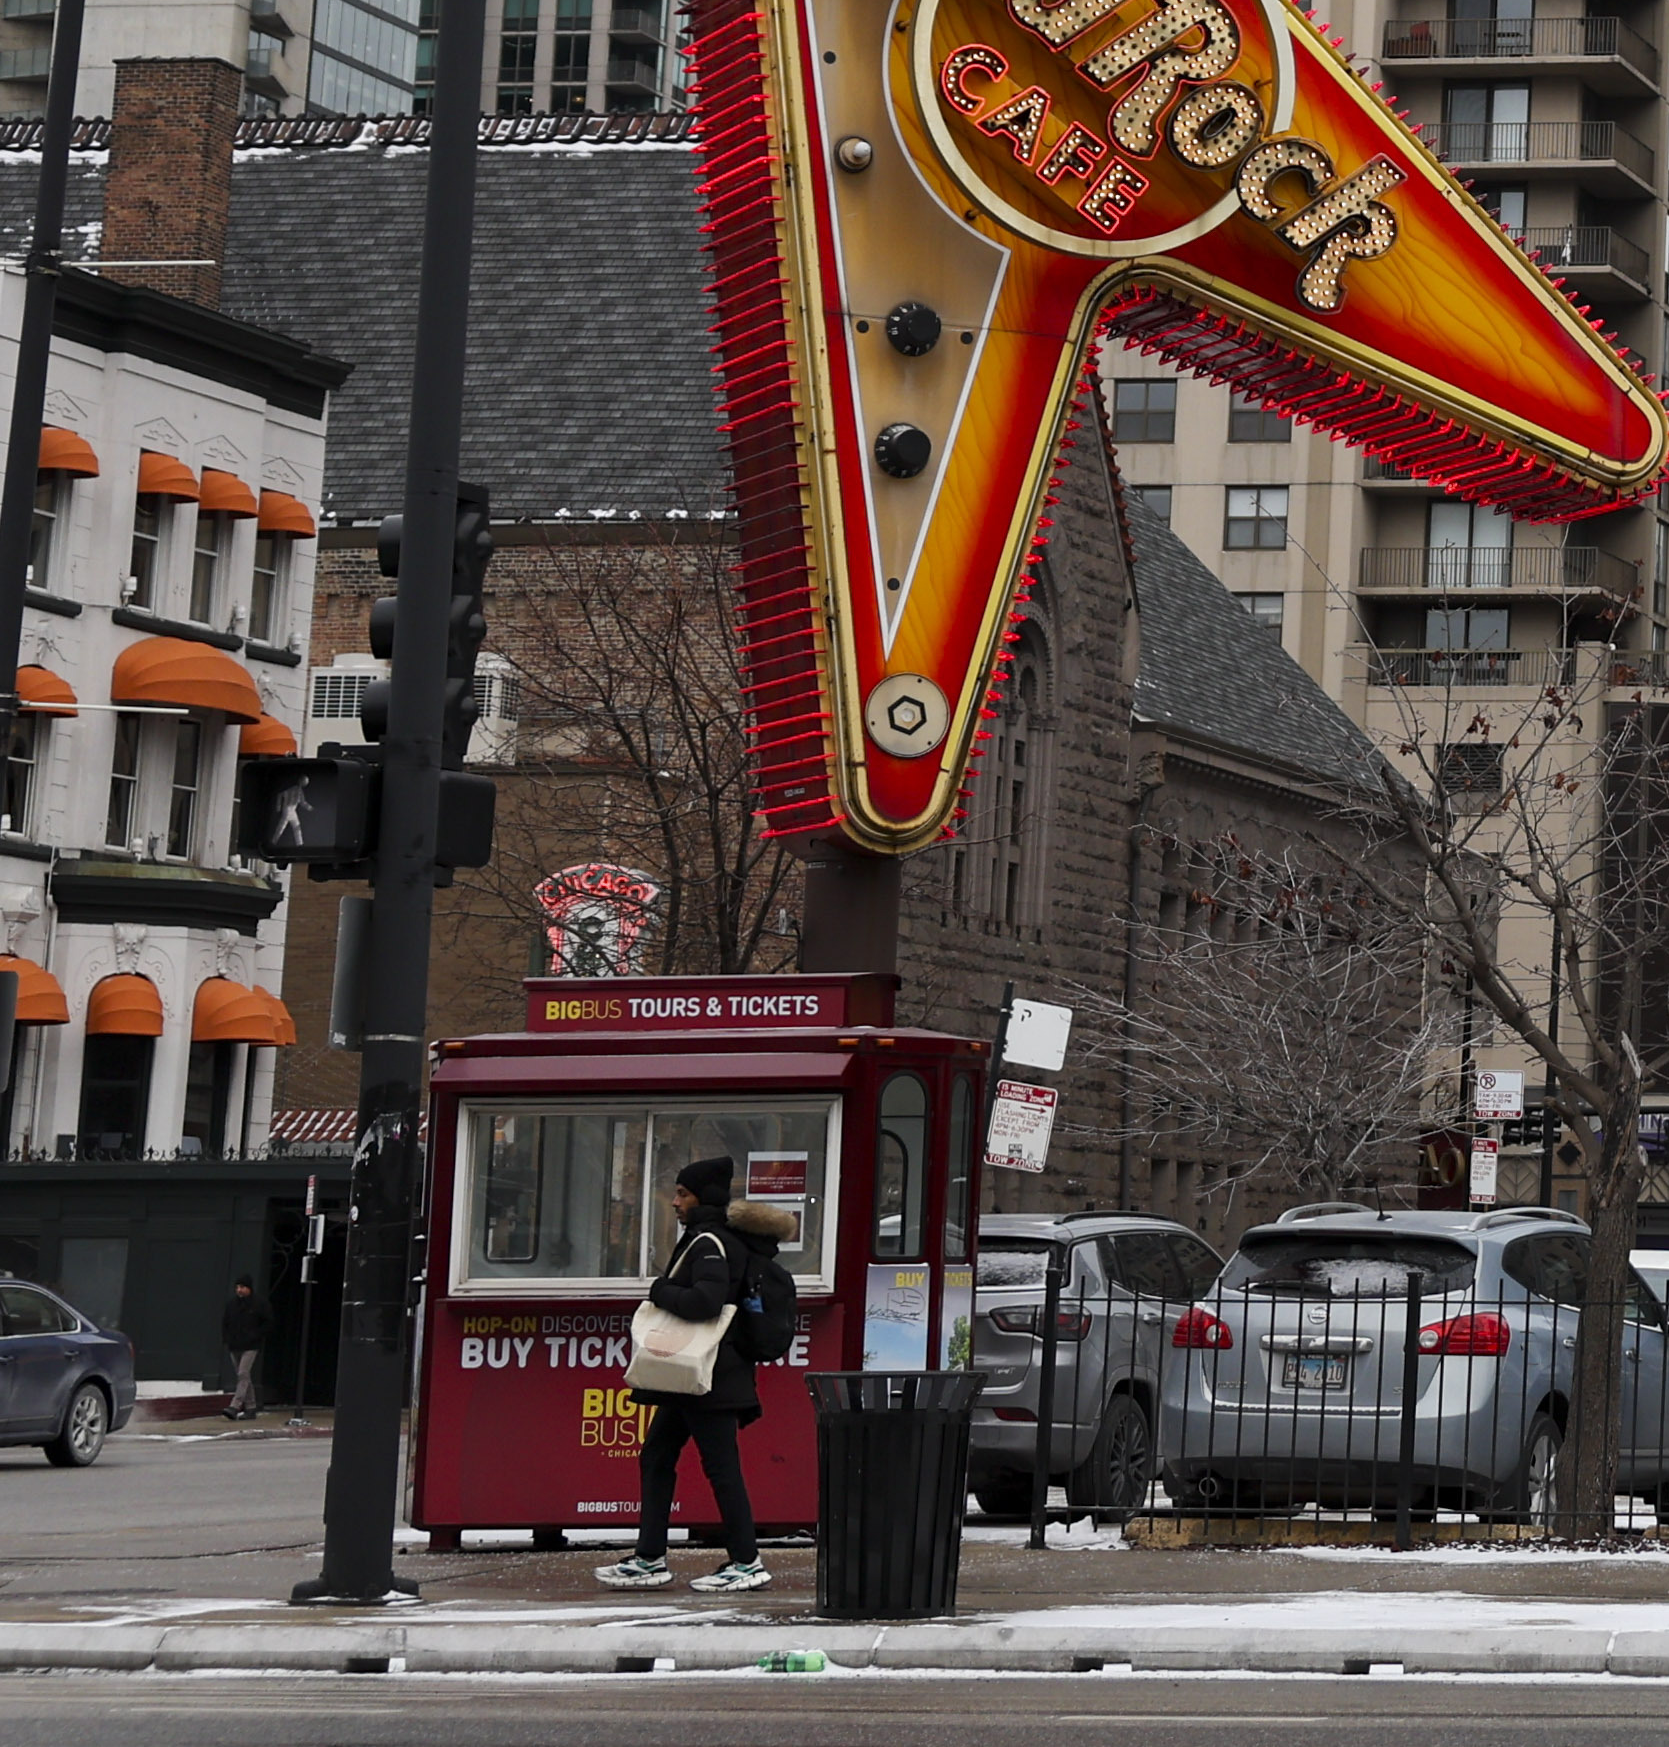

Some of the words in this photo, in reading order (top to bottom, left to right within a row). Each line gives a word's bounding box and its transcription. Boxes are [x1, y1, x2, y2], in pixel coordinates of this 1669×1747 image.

[940, 43, 1149, 234] CAFE
[545, 999, 622, 1020] BIGBUS
[629, 997, 700, 1019] TOURS
[706, 997, 722, 1017] &
[728, 995, 819, 1016] TICKETS
[1000, 1091, 1027, 1101] LOADING
[1011, 1084, 1034, 1095] MINUTE
[989, 1154, 1009, 1165] TOW
[896, 1272, 925, 1287] BUY
[463, 1317, 536, 1334] HOP-ON
[542, 1315, 631, 1334] DISCOVER
[461, 1337, 534, 1369] BUY
[545, 1336, 628, 1368] TICK
[1314, 1364, 1343, 1381] 210
[582, 1388, 636, 1418] BIG
[580, 1420, 636, 1447] BUS
[608, 1449, 641, 1458] CHICA
